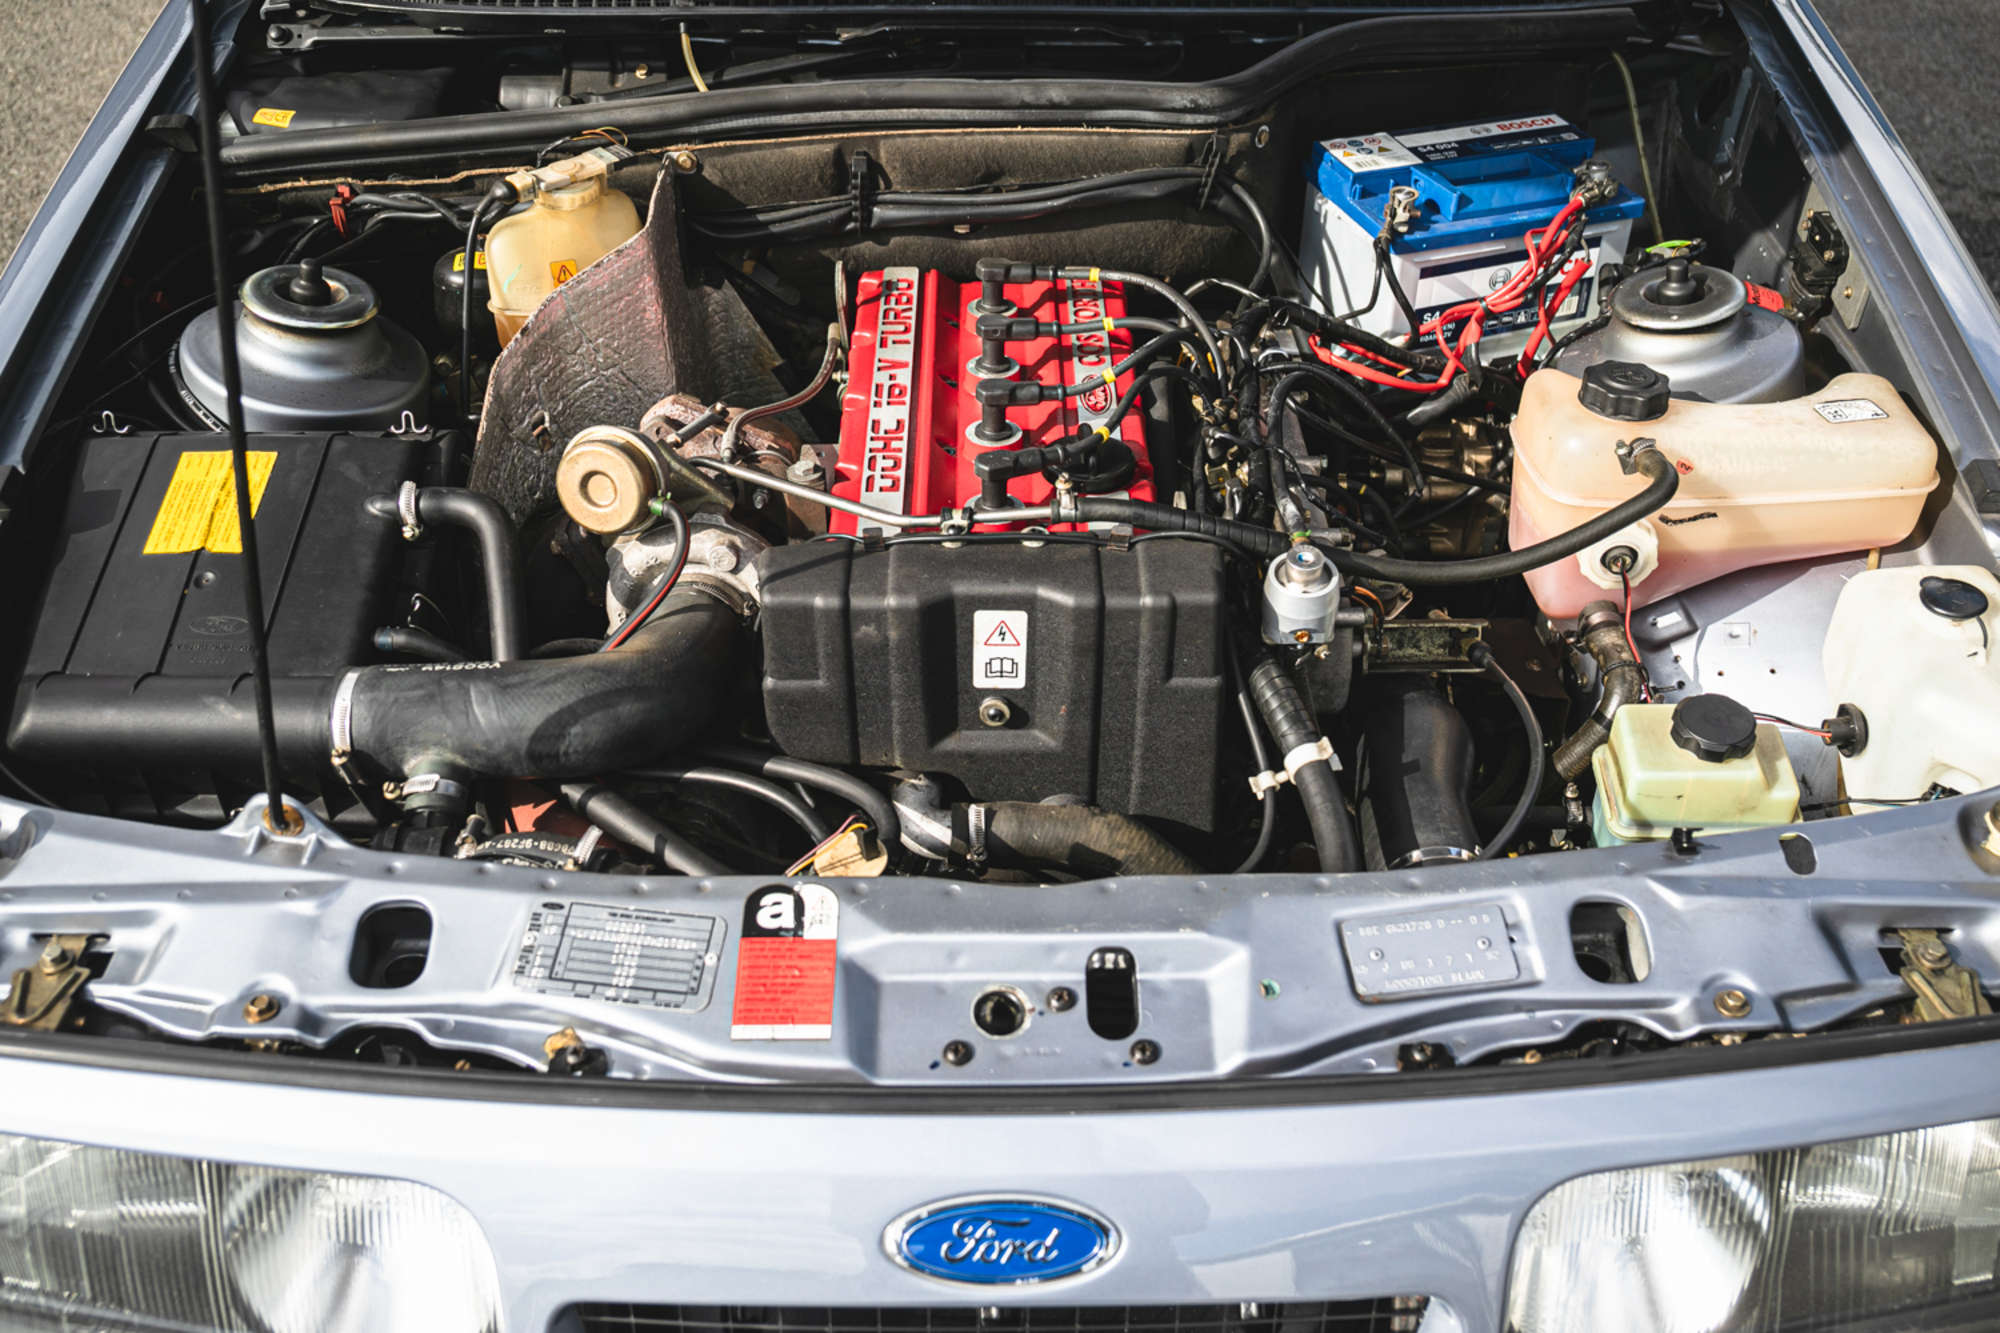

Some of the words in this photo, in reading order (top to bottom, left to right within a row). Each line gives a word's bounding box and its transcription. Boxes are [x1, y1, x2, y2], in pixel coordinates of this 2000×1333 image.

[1496, 116, 1556, 132] BOSCH
[879, 277, 914, 350] TURBO
[1072, 278, 1107, 367] COSORTH
[865, 418, 905, 493] DOHC
[939, 1215, 1060, 1265] Ford
